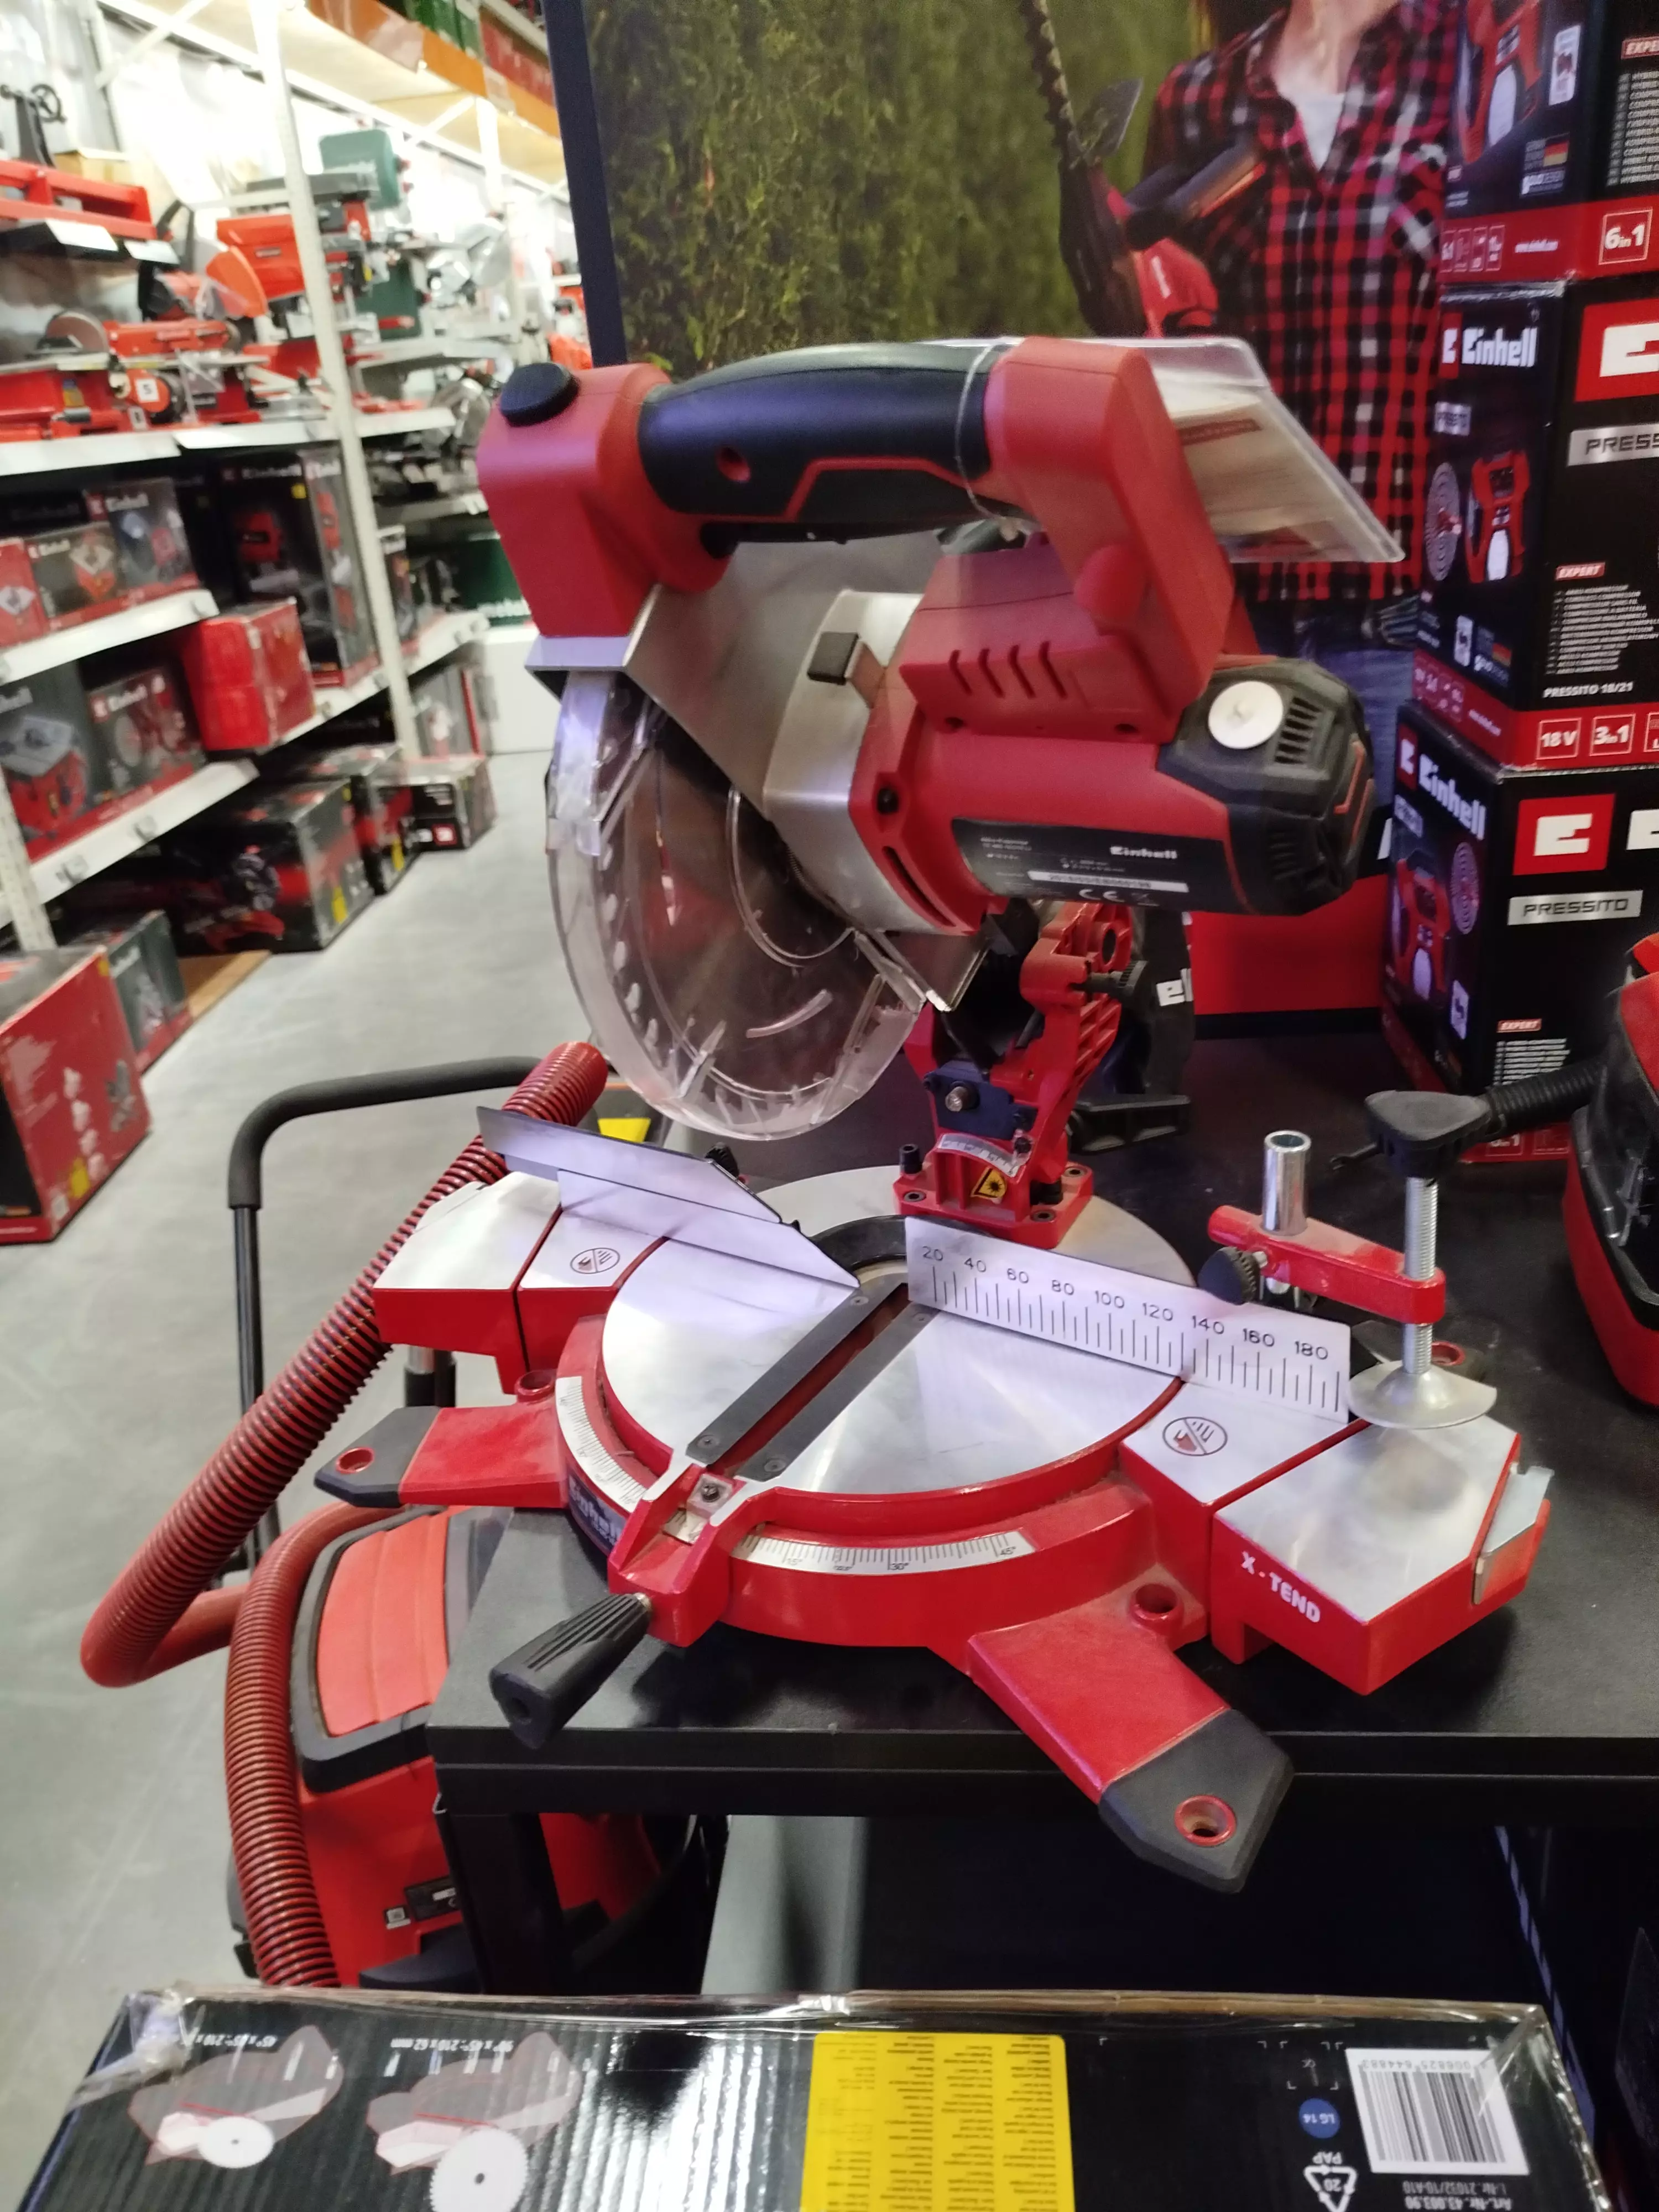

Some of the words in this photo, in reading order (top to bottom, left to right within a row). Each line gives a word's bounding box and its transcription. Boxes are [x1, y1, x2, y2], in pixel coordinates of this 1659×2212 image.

[1462, 327, 1538, 367] Einhell
[1542, 685, 1599, 698] PRESSITO
[1419, 753, 1486, 841] Einhell
[1524, 898, 1629, 917] PRESSITO
[922, 1245, 943, 1261] 20
[964, 1258, 986, 1272] 40
[1007, 1267, 1029, 1284] 60
[1052, 1280, 1074, 1296] 80
[1095, 1290, 1125, 1308] 100
[1142, 1302, 1173, 1321] 120
[1192, 1315, 1224, 1334] 140
[1243, 1328, 1275, 1347] 160
[1295, 1341, 1328, 1360] 180
[889, 1562, 909, 1571] 30°
[1312, 2151, 1343, 2165] PAP
[1323, 2177, 1342, 2192] 20
